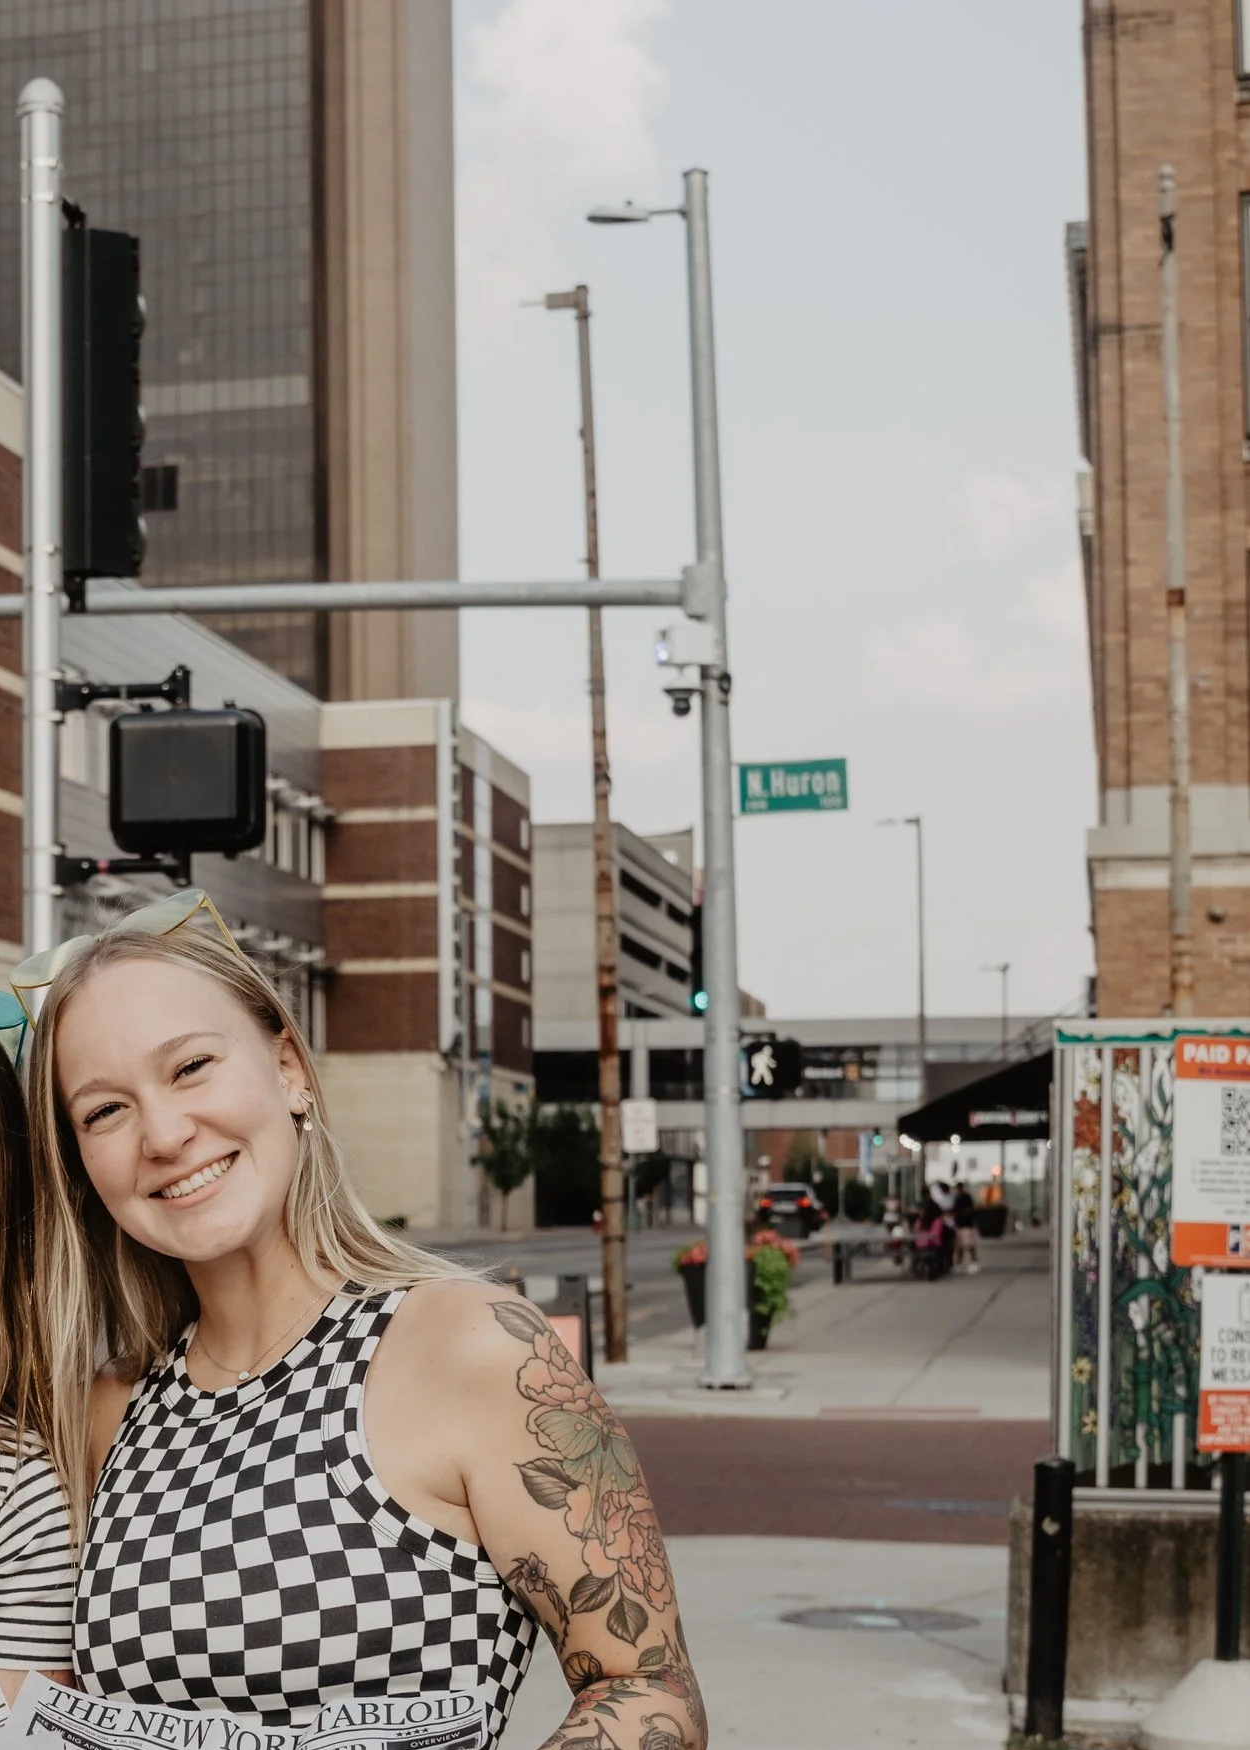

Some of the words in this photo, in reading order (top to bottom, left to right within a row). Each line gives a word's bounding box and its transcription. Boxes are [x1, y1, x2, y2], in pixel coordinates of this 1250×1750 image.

[1183, 1043, 1230, 1064] PAID
[49, 1686, 121, 1730] THE
[124, 1709, 215, 1750] NEW
[67, 1732, 82, 1744] BIG
[410, 1731, 461, 1748] OVERVIEW
